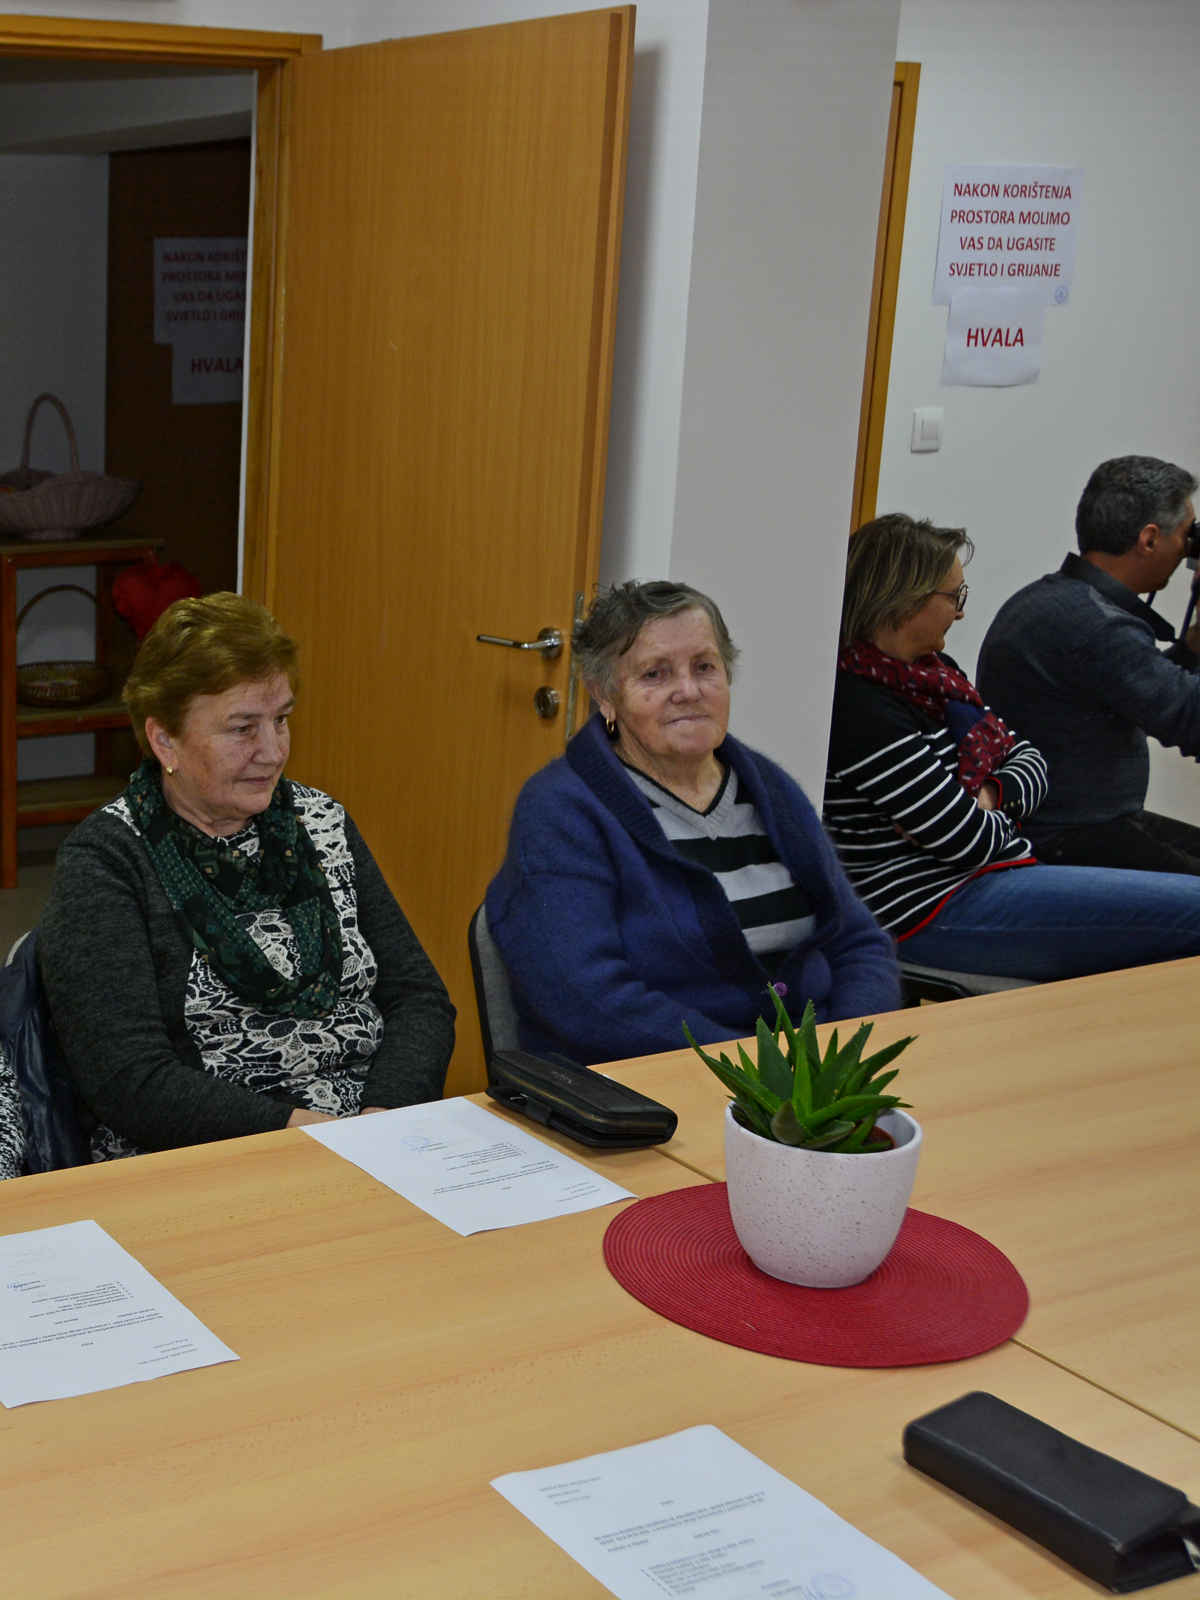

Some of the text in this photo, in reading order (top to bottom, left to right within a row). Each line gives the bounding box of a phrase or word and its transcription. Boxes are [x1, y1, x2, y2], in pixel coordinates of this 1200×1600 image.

[953, 181, 1072, 199] NAKON KORIŠTENJA
[950, 209, 1071, 225] PROSTORA MOLIMO
[959, 237, 1056, 251] VAS DA UGASITE
[948, 263, 1061, 277] SVJETLO I GRIJANJE
[966, 327, 1025, 348] HVALA
